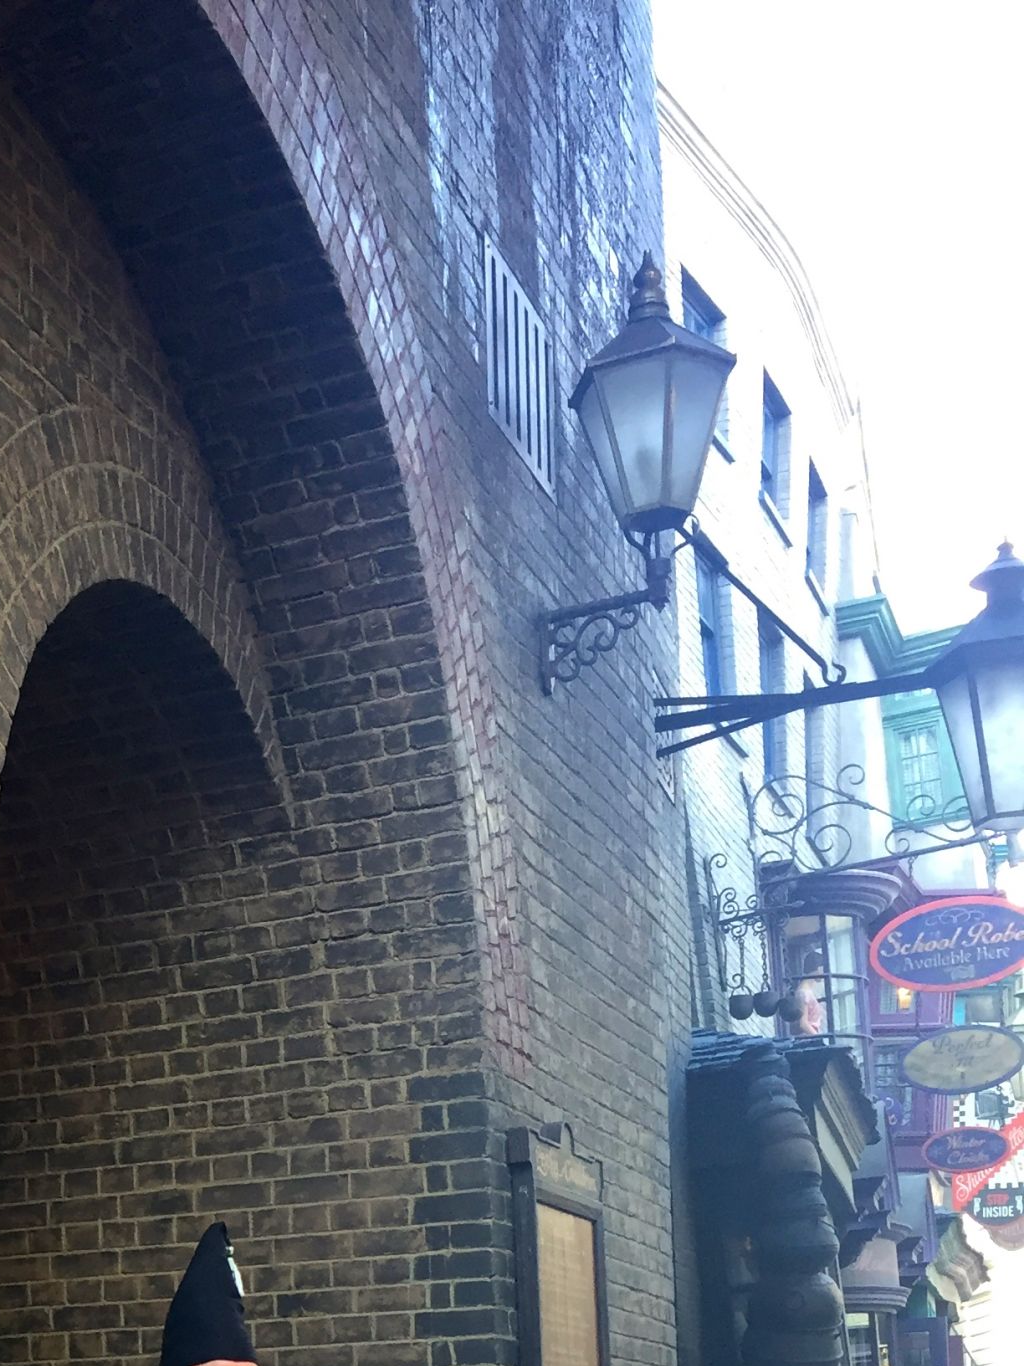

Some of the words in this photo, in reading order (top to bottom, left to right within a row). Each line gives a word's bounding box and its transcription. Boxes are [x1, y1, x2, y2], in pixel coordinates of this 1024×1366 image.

[880, 926, 963, 957] School
[962, 921, 1024, 947] Robe
[903, 950, 972, 972] Available
[982, 1205, 1014, 1218] INSIDE
